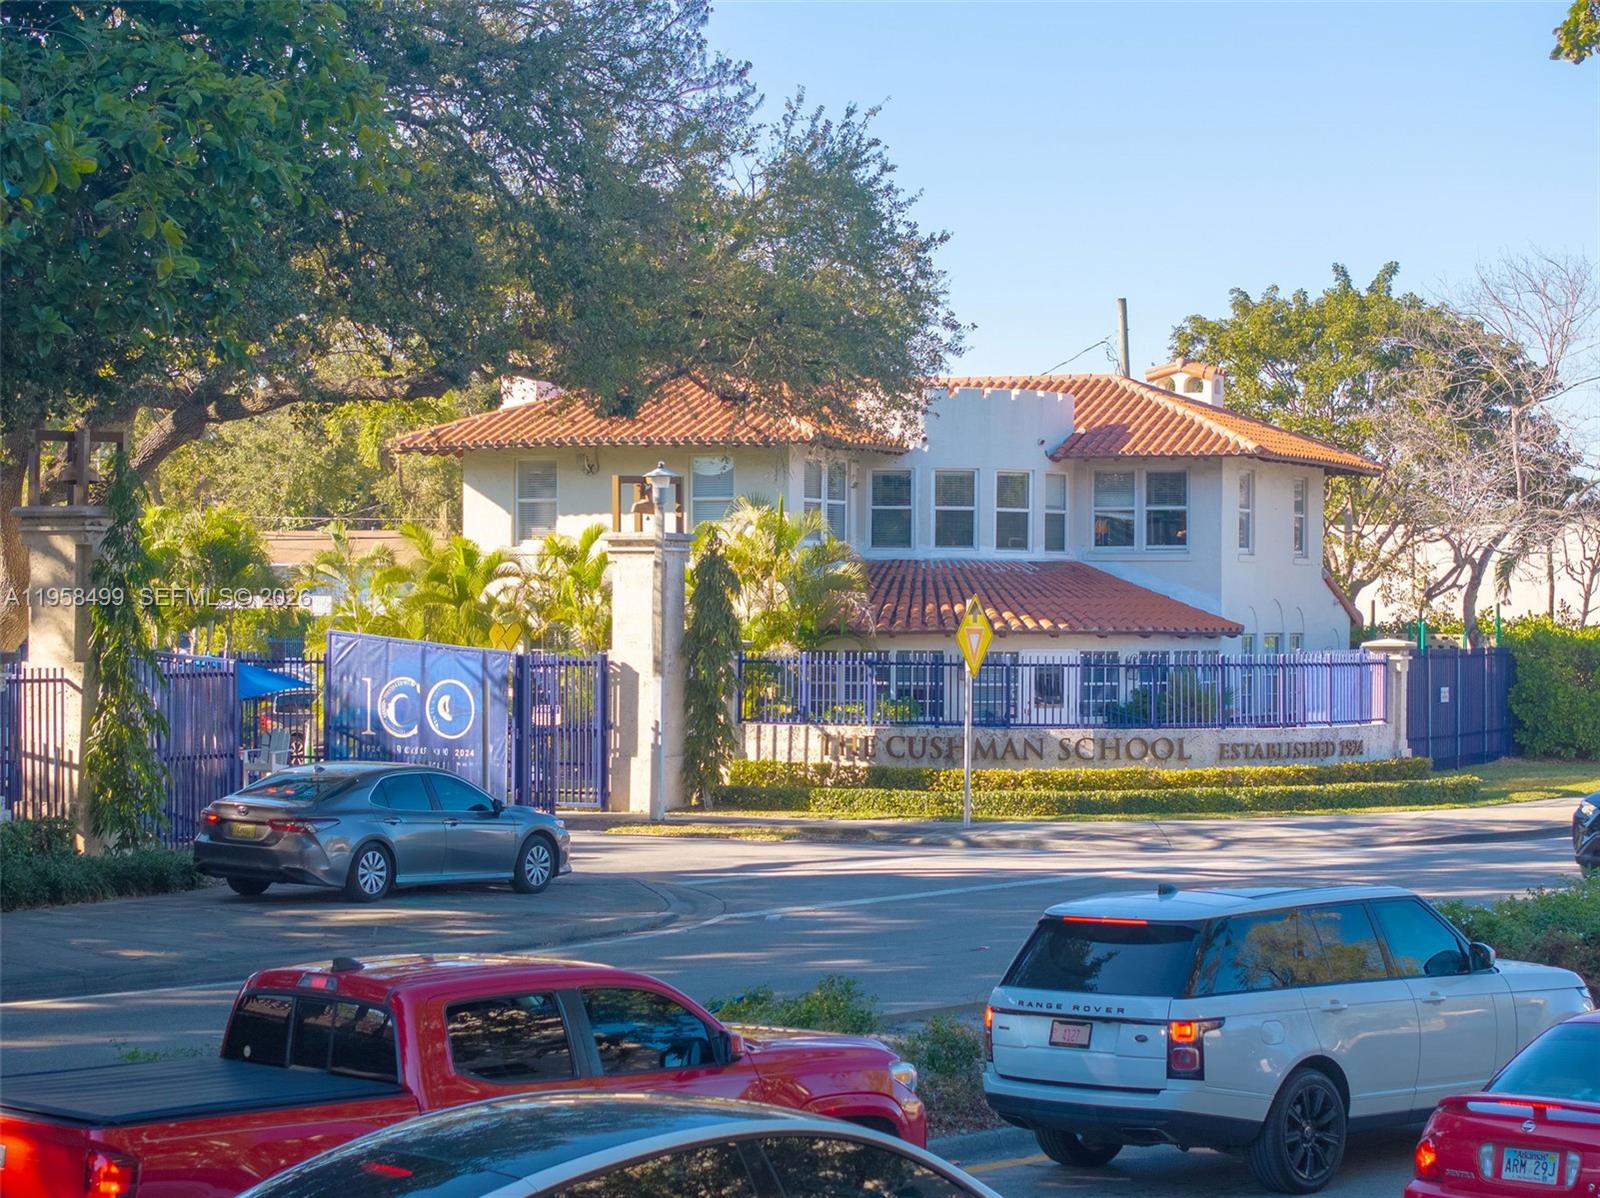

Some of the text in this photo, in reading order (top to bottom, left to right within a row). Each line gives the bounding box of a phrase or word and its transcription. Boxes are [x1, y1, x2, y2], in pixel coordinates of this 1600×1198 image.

[454, 748, 475, 757] 2024
[885, 735, 1044, 761] CUSHMAN
[1058, 736, 1192, 761] SCHOOL
[1218, 739, 1336, 761] ESTABLISHED
[1018, 1000, 1125, 1014] RANGE ROVER
[1505, 1157, 1556, 1177] ARM 29J
